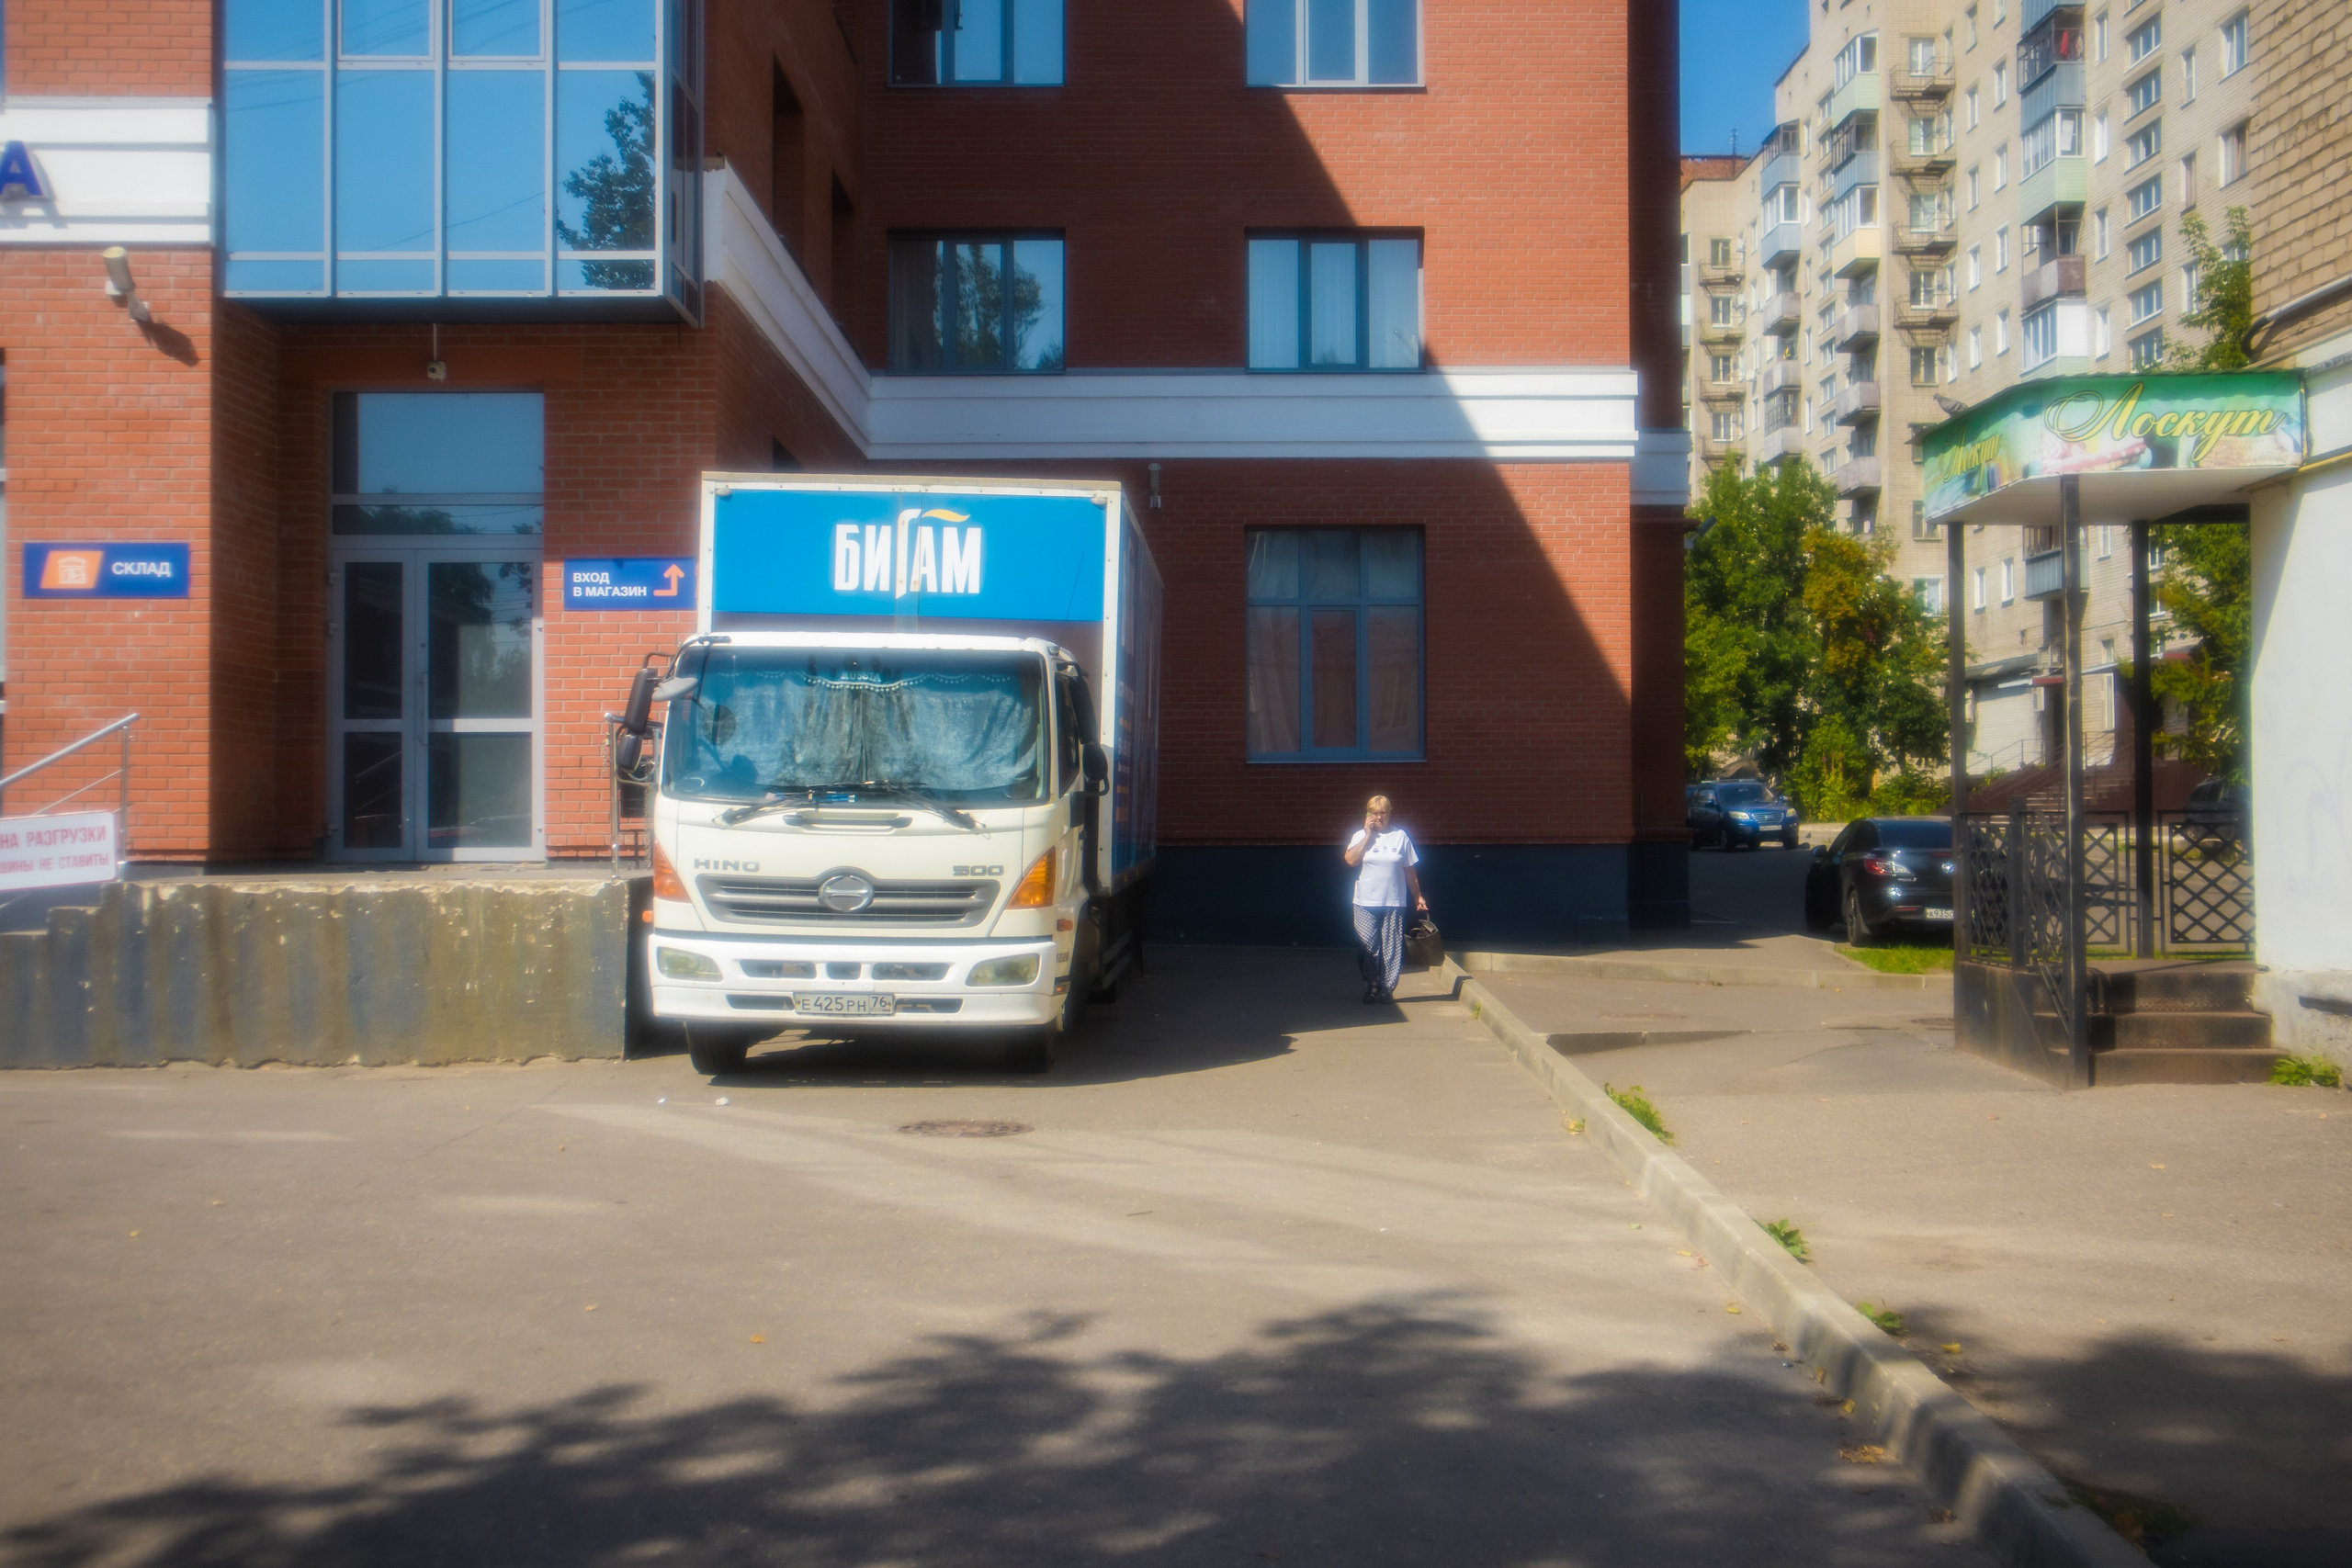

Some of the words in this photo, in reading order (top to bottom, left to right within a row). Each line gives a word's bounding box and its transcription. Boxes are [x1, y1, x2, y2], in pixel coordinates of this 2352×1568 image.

[2044, 381, 2287, 462] Лоскут
[834, 508, 981, 599] БИГАМ
[111, 561, 171, 577] СКЛАД
[572, 572, 610, 584] ВХОД
[572, 587, 582, 597] В
[585, 586, 647, 597] МАГАЗИН
[26, 826, 107, 847] РАЗГРУЗКИ
[39, 858, 53, 870] НЕ
[694, 858, 760, 873] HINO
[953, 865, 1004, 876] 500
